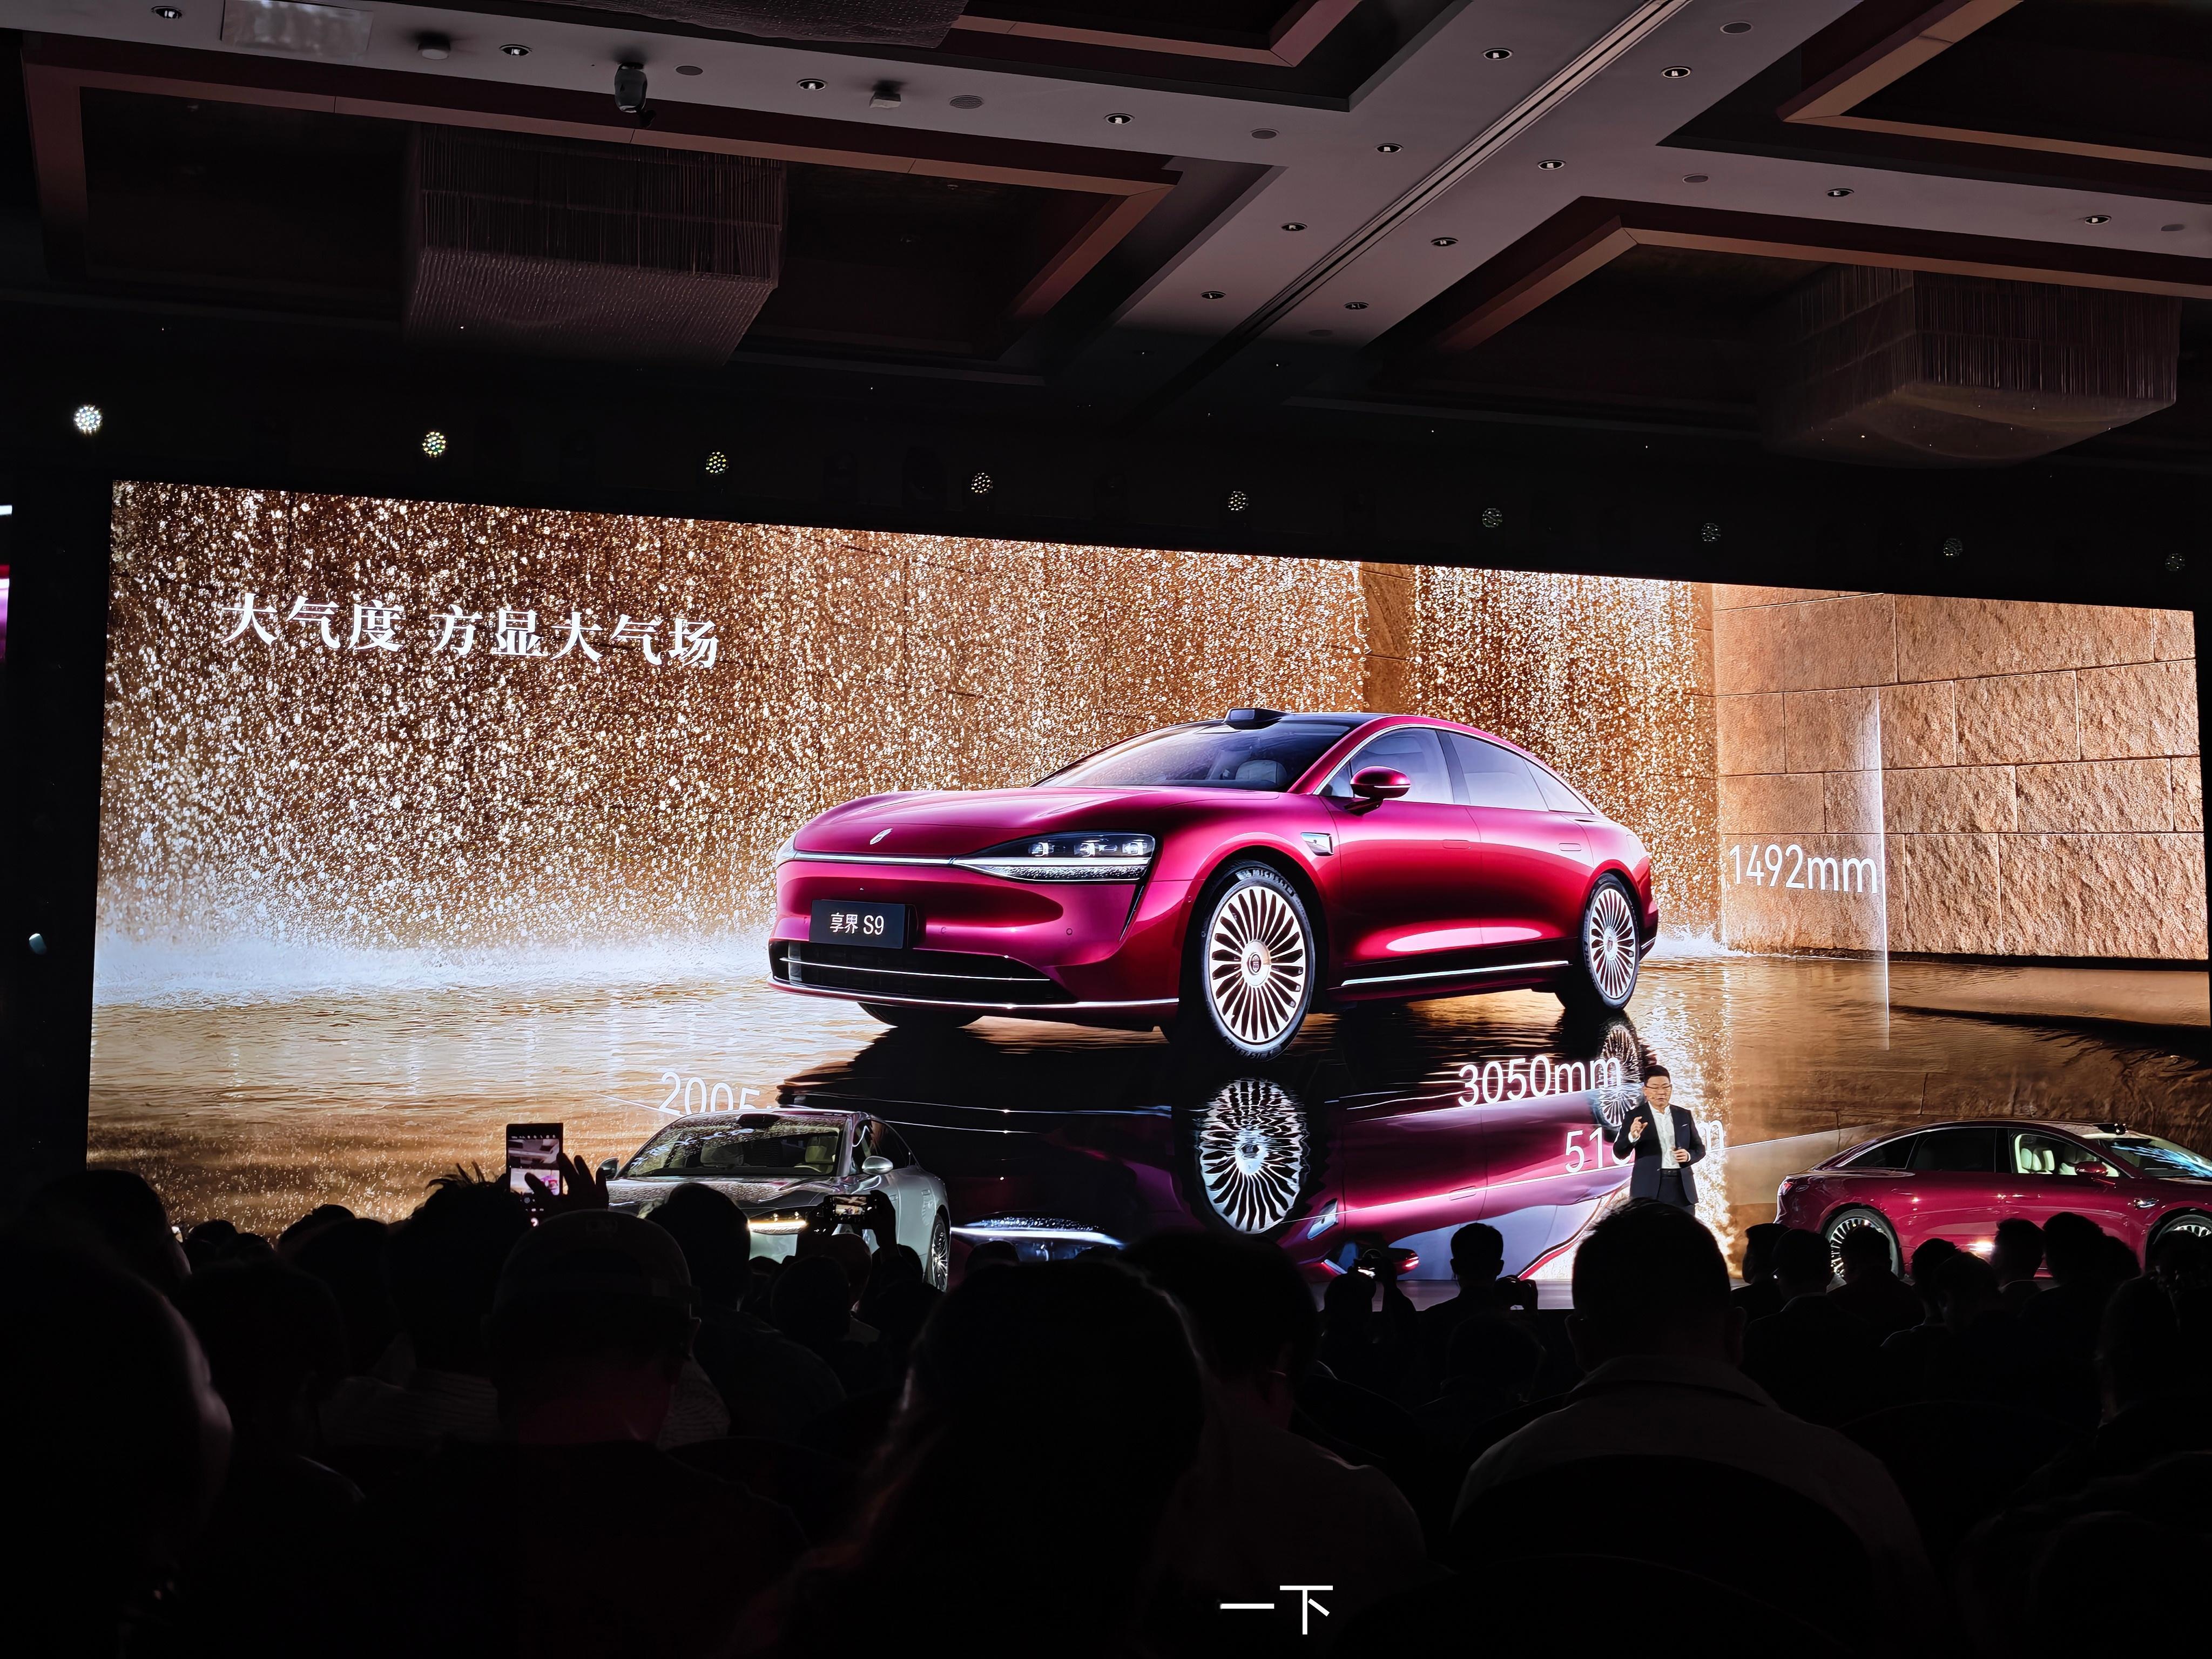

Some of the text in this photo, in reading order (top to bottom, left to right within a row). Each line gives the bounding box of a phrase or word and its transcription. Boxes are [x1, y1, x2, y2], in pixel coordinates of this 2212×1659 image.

[221, 592, 720, 669] 大气度 方显大气场
[1729, 843, 1877, 894] 1492mm
[830, 912, 884, 935] 享界 S9
[659, 1071, 781, 1116] 2005
[1458, 1055, 1621, 1107] 3050mm
